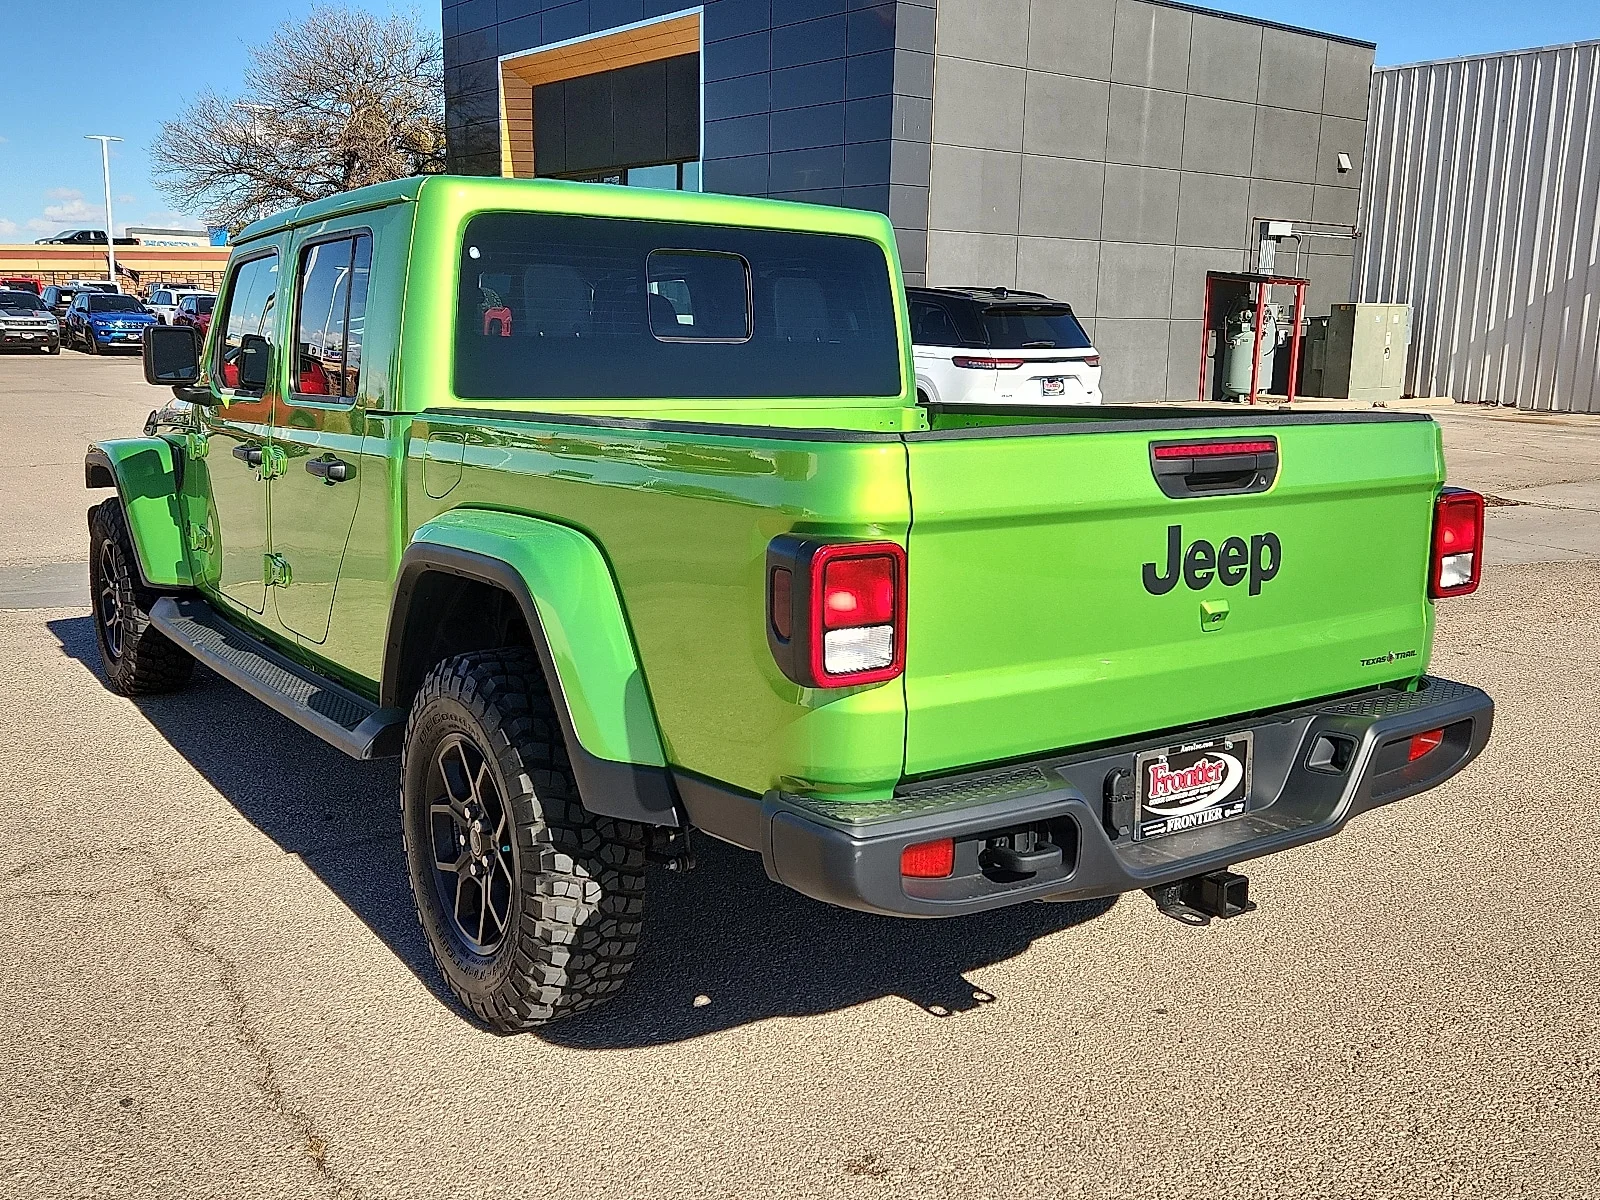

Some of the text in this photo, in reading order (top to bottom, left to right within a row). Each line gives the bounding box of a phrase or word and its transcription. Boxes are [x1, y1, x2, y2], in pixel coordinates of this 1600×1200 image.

[1142, 524, 1282, 596] Jeep
[1360, 649, 1418, 667] TEXAS TRAIL
[1149, 760, 1224, 797] Frontier
[1166, 807, 1223, 833] FRONTIER
